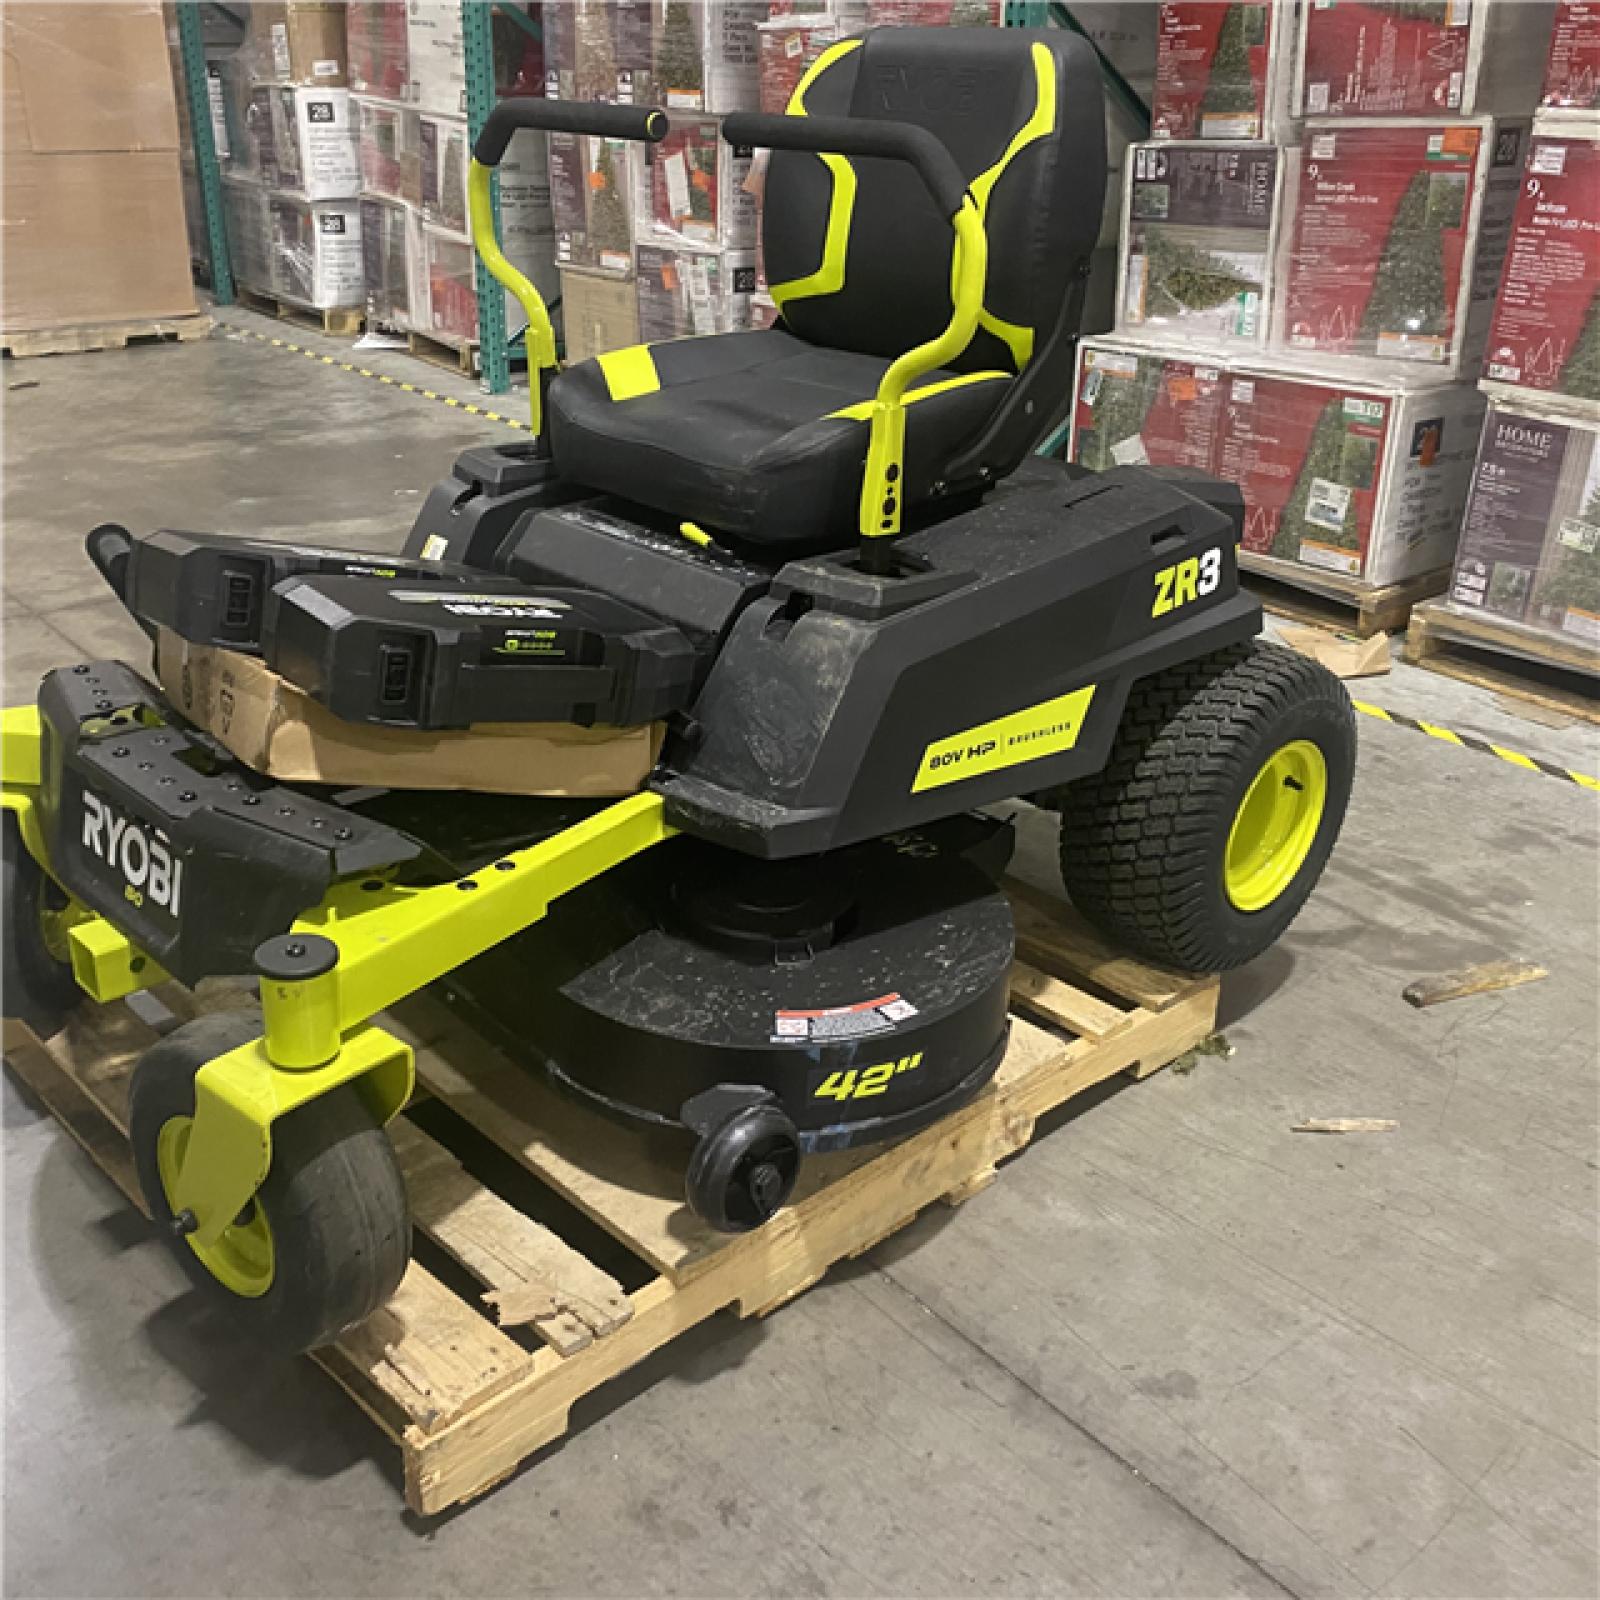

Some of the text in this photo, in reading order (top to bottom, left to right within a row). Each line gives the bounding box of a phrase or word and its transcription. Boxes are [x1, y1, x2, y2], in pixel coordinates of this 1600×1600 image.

[1496, 424, 1553, 449] HOME
[1152, 547, 1221, 618] ZR3
[929, 749, 964, 770] 80V
[967, 740, 996, 760] HP
[82, 789, 183, 917] RYOBI
[815, 1052, 923, 1100] 42"
